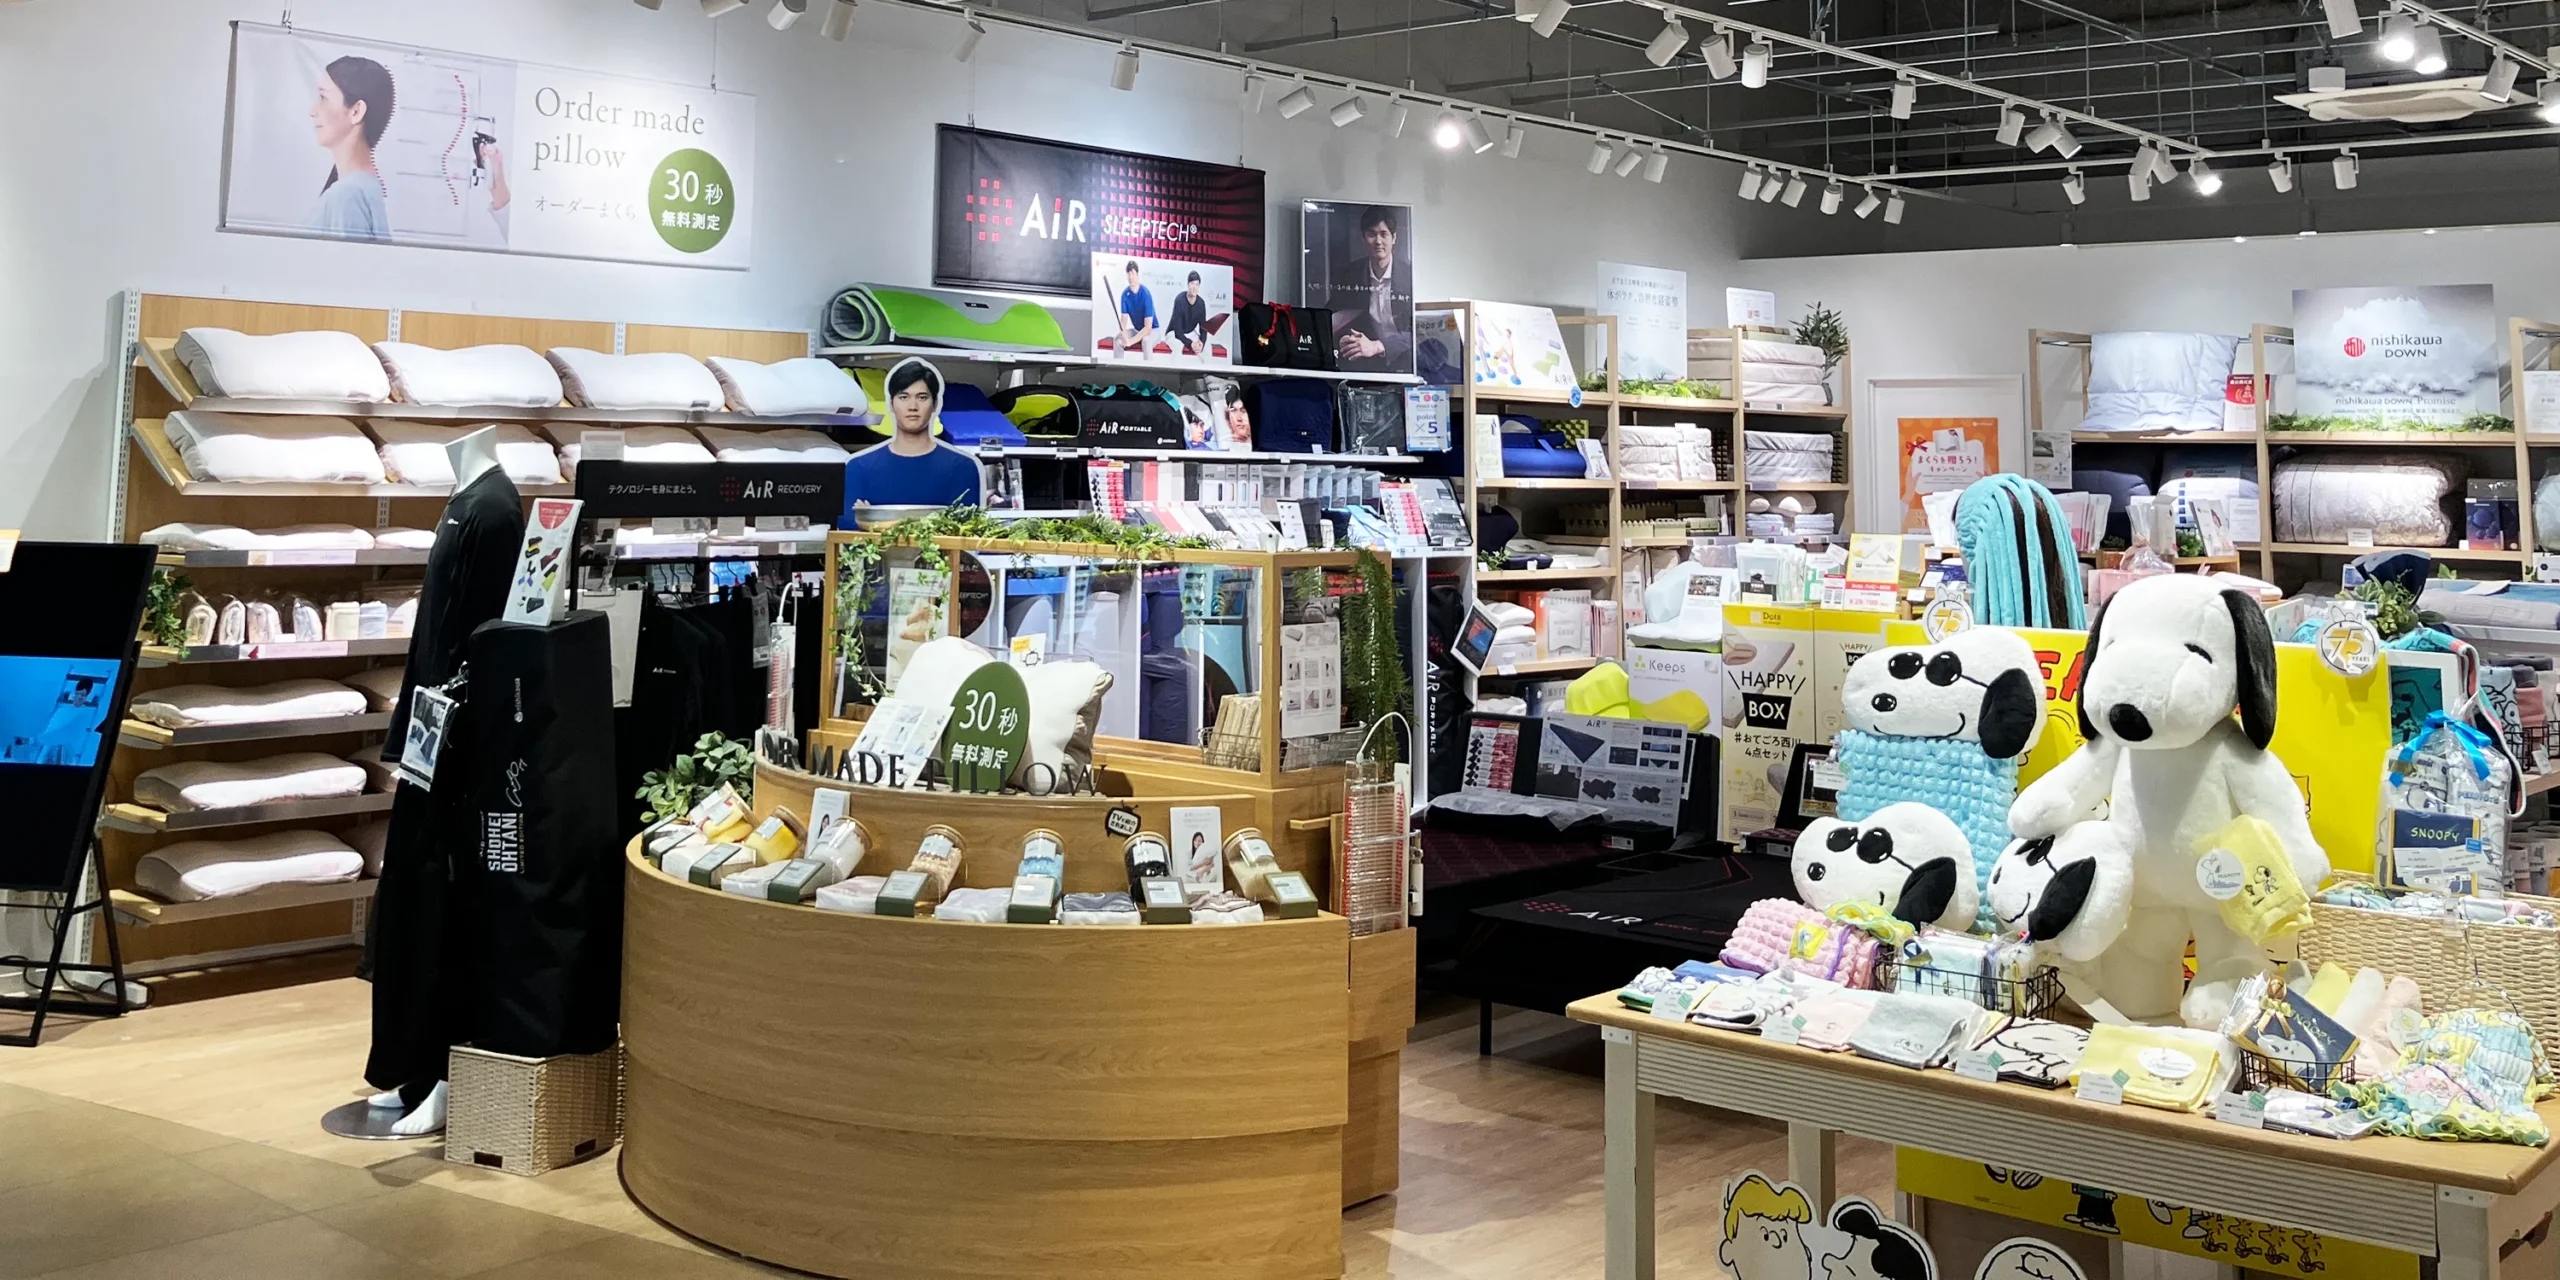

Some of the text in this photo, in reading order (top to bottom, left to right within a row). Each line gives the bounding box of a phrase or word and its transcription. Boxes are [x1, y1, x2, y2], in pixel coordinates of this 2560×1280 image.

[535, 87, 705, 135] Order made
[532, 133, 627, 171] pillow
[535, 196, 636, 222] オーダーまくら
[662, 210, 721, 231] 無料測定
[2371, 334, 2443, 346] nishikawa
[2385, 349, 2427, 358] DOWN
[2336, 397, 2382, 405] nishikawa
[608, 484, 697, 495] テクノロジーを身にまとう。
[778, 484, 822, 494] RECOVERY
[1844, 643, 1868, 651] HAPPY
[1649, 659, 1686, 674] Keeps
[2350, 655, 2371, 663] YEARS
[1741, 671, 1797, 690] HAPPY
[1748, 701, 1786, 720] BOX
[1734, 732, 1802, 748] #おてごろ西川
[950, 742, 1010, 769] 無料測定
[1745, 748, 1788, 761] 4点セット
[809, 743, 905, 789] MADE
[925, 757, 1107, 797] PILLOW
[487, 812, 501, 871] SHOHEI
[501, 812, 518, 873] OHTANI
[2411, 827, 2460, 842] SNOOPY
[2293, 1010, 2336, 1045] NOOPY
